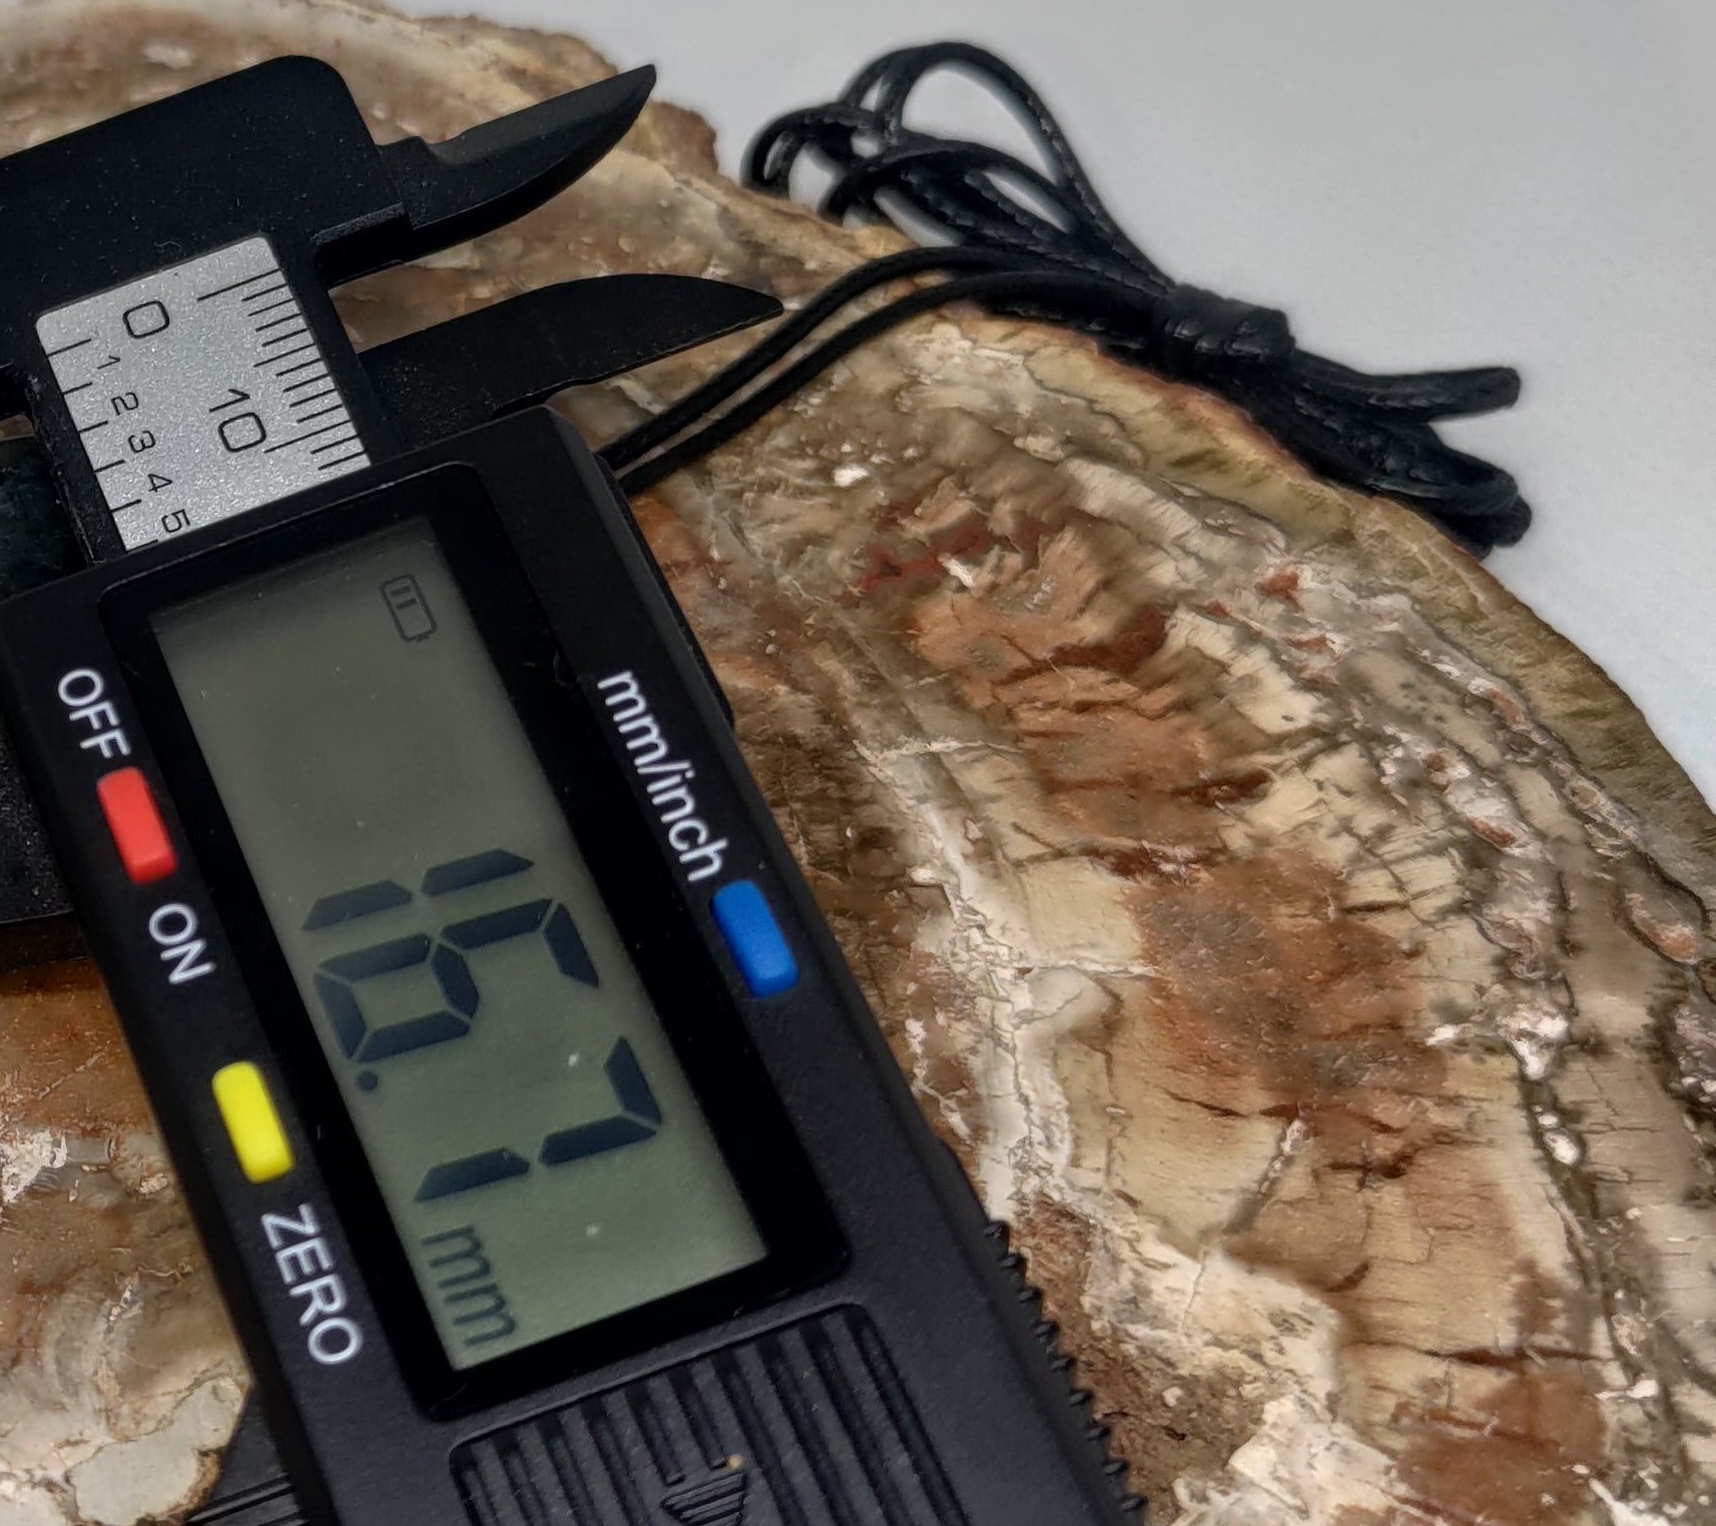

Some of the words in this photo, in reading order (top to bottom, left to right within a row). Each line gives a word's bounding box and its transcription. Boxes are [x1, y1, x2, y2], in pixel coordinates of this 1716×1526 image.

[97, 355, 121, 369] 1
[111, 392, 139, 416] 2
[128, 430, 156, 454] 3
[148, 474, 173, 493] 4
[162, 509, 191, 533] 5
[123, 300, 169, 339] 0
[209, 388, 267, 453] 10
[597, 670, 725, 882] mm/inch
[57, 668, 131, 761] OFF
[147, 902, 216, 985] ON
[261, 1203, 363, 1366] ZERO
[301, 848, 662, 1202] 16.7
[420, 1225, 519, 1348] mm
